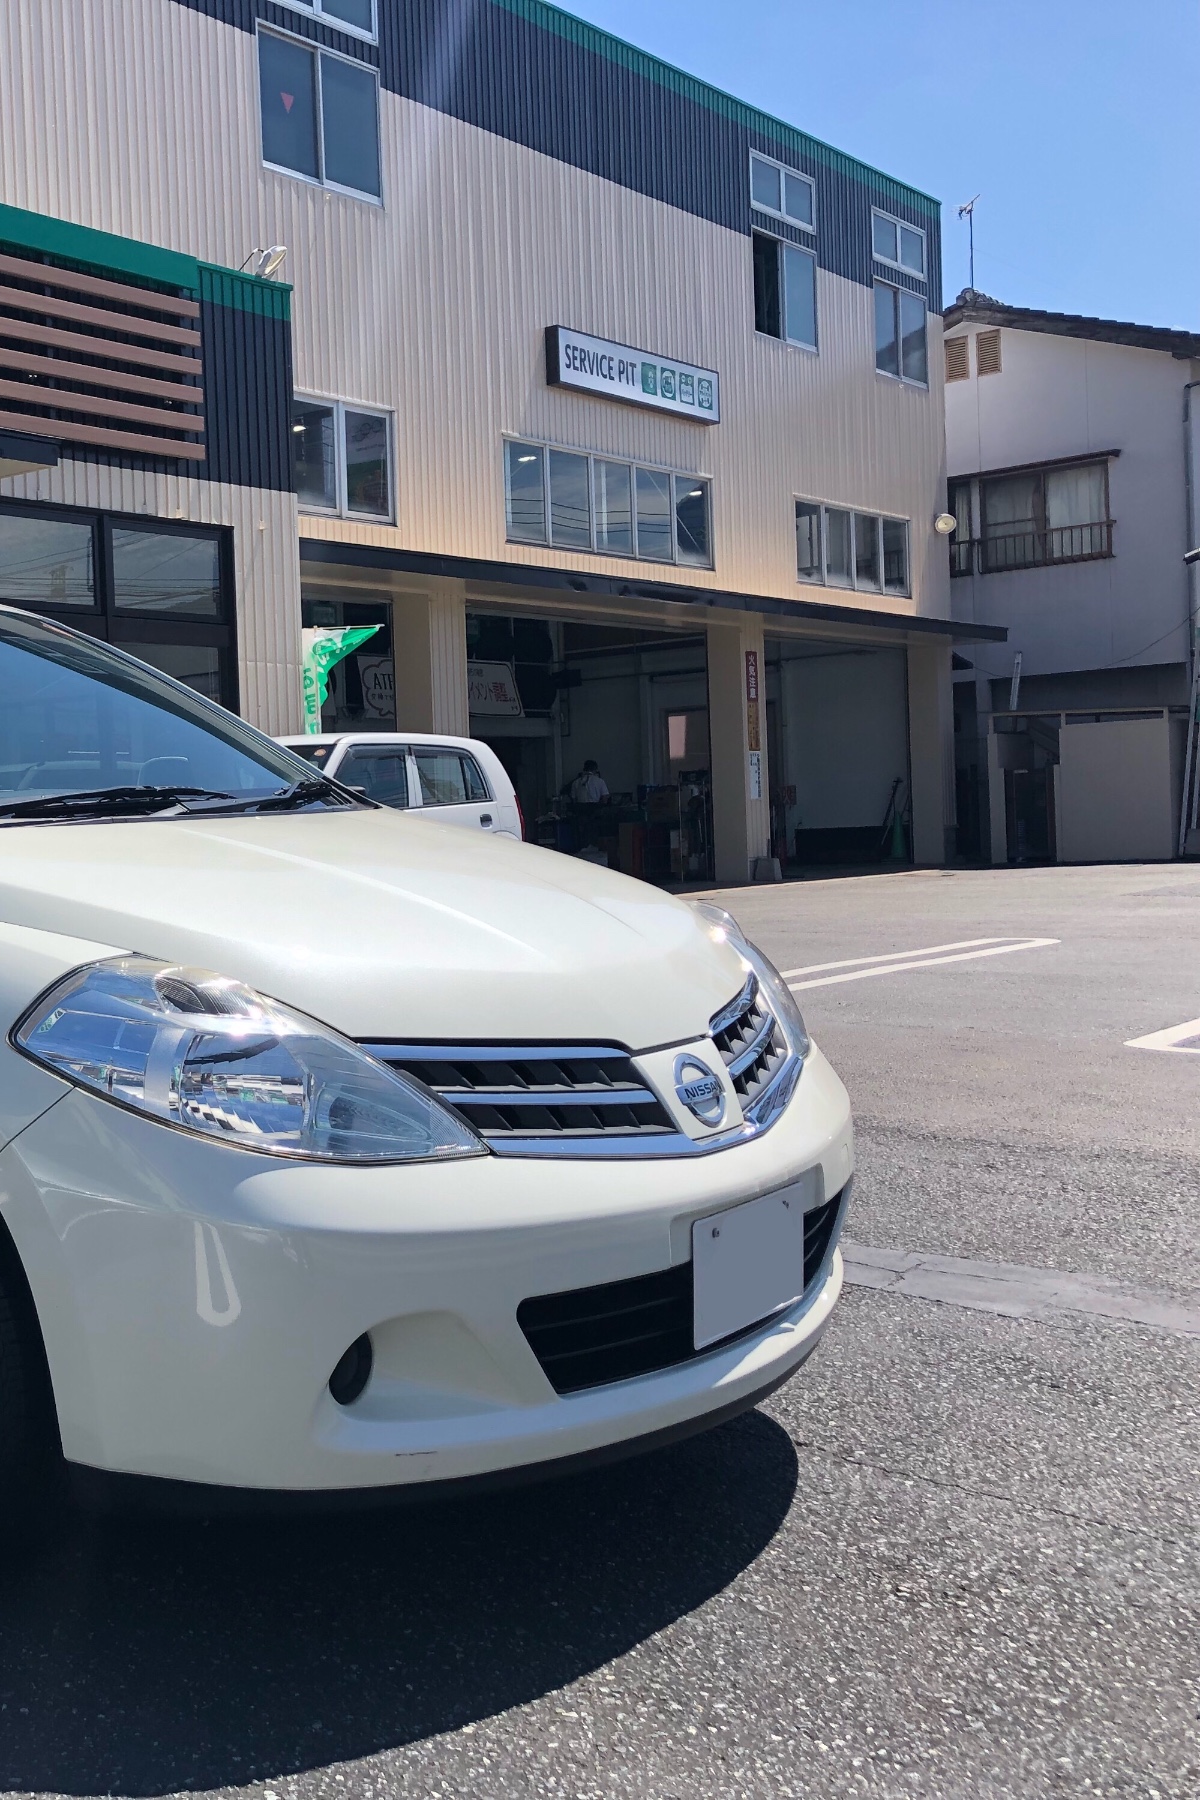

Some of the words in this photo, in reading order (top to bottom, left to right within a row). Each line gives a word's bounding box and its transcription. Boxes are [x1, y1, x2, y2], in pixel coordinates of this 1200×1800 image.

[564, 343, 615, 381] SERVICE
[618, 358, 637, 386] PIT
[684, 1080, 719, 1099] NISSAN
